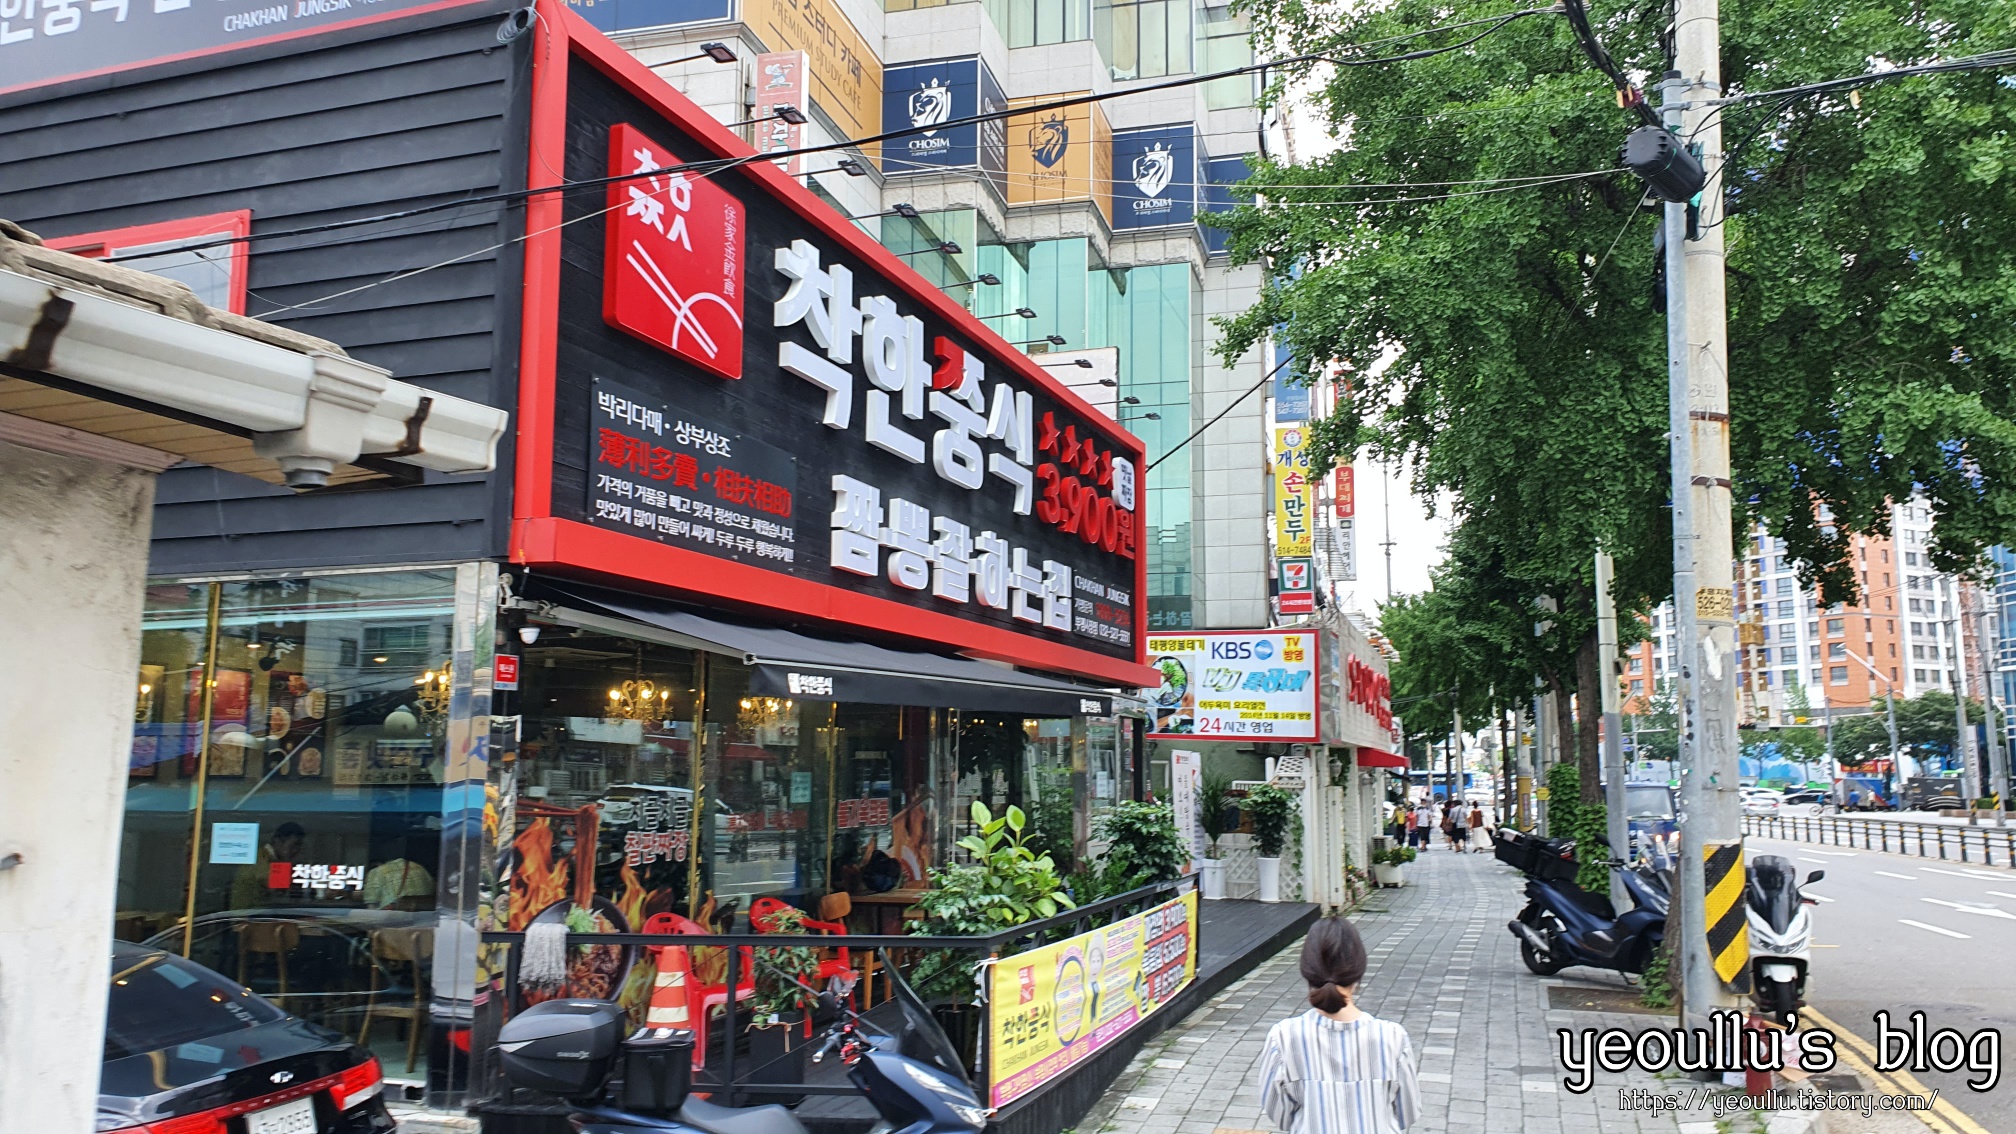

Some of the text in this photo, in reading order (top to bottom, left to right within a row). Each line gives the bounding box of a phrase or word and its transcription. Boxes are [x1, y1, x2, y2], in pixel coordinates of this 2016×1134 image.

[224, 5, 288, 32] CHAKHAN
[815, 46, 842, 87] STUDY
[843, 79, 861, 111] CAFE
[841, 47, 861, 88] 카페
[908, 138, 950, 149] CHOSIM
[1029, 170, 1068, 182] CHOSIM
[1132, 198, 1173, 210] CHOSIM
[774, 238, 1034, 516] 착한중식
[597, 474, 633, 500] 가격의
[634, 484, 667, 508] 거품을
[669, 494, 691, 513] 빼고
[692, 500, 713, 520] 맛과
[714, 506, 751, 530] 정성으로
[1283, 471, 1306, 542] 손만두
[1338, 471, 1351, 513] 부대찌개
[595, 499, 631, 524] 맛있게
[633, 509, 656, 531] 많이
[657, 514, 690, 538] 만들어
[716, 530, 735, 549] 두루
[736, 536, 755, 553] 두루
[1211, 637, 1300, 660] KBS TV
[1283, 648, 1304, 661] 방영
[1250, 721, 1274, 733] 영업
[628, 796, 689, 830] 지글지글
[624, 829, 690, 866] 철판짜장
[291, 863, 365, 890] 착한중식
